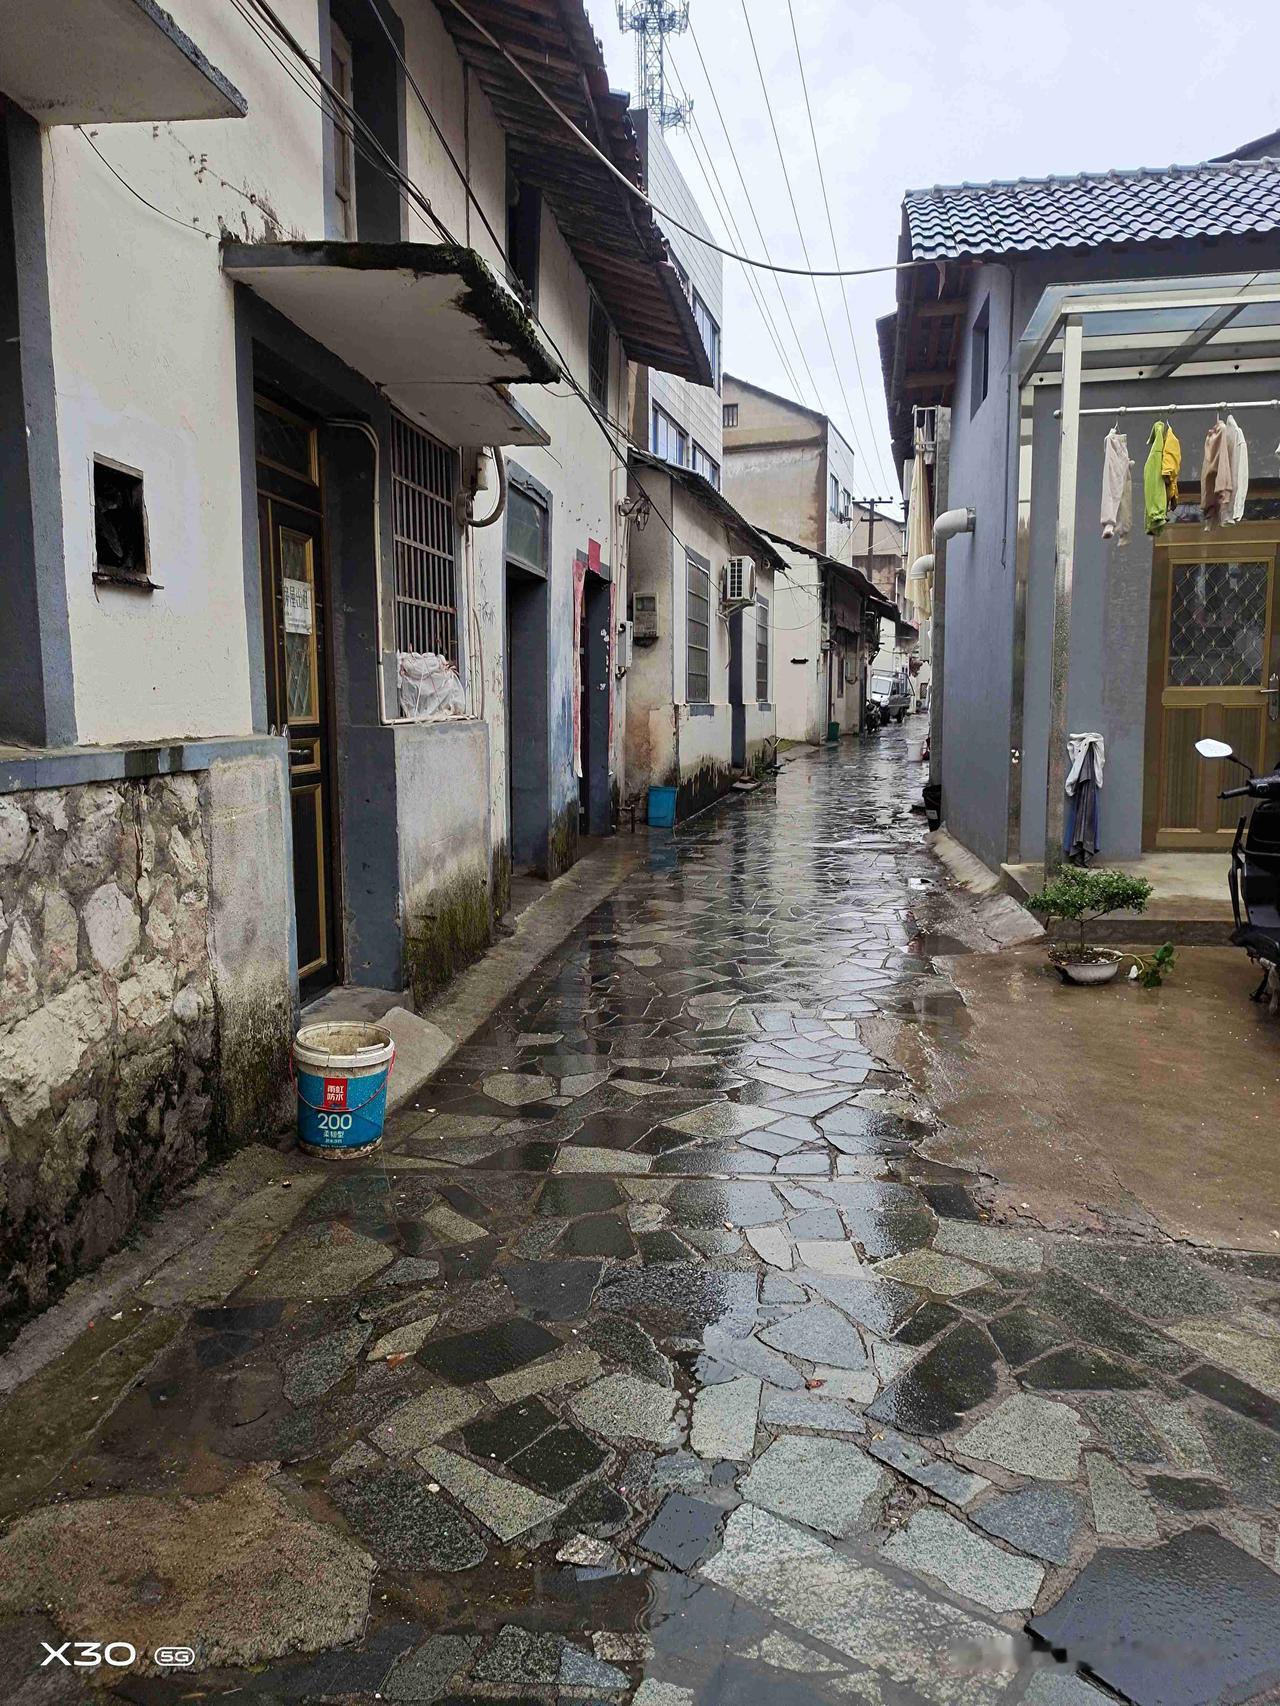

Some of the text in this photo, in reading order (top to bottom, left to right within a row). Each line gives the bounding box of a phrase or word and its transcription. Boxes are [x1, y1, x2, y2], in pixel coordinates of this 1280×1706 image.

[327, 1085, 345, 1093] 雨虹
[326, 1093, 344, 1101] 防水
[317, 1113, 352, 1130] 200
